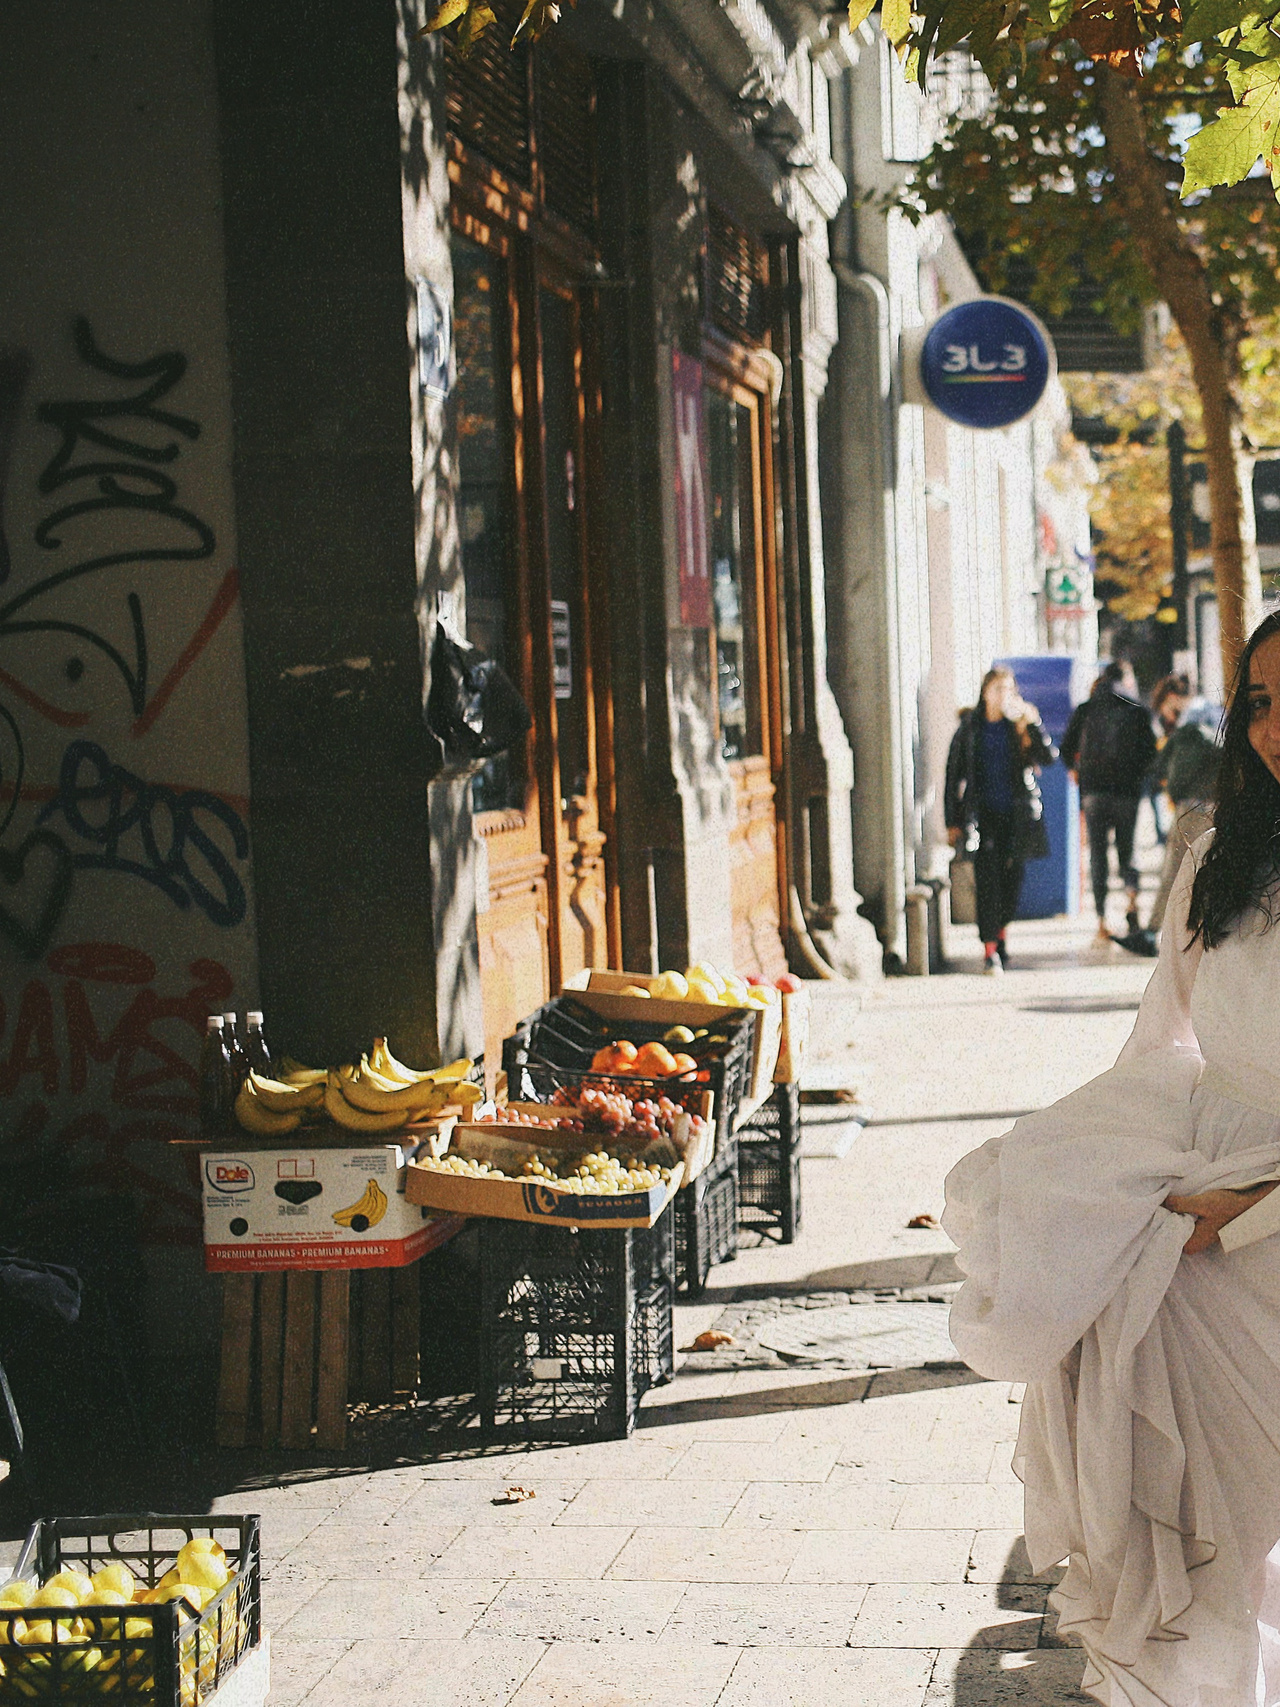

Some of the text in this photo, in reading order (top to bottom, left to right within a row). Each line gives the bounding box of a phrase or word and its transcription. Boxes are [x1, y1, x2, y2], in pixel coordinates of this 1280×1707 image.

[216, 1166, 249, 1180] Dole
[216, 1246, 385, 1259] PREMIUM BANANAS PREMIUM BANANAS
